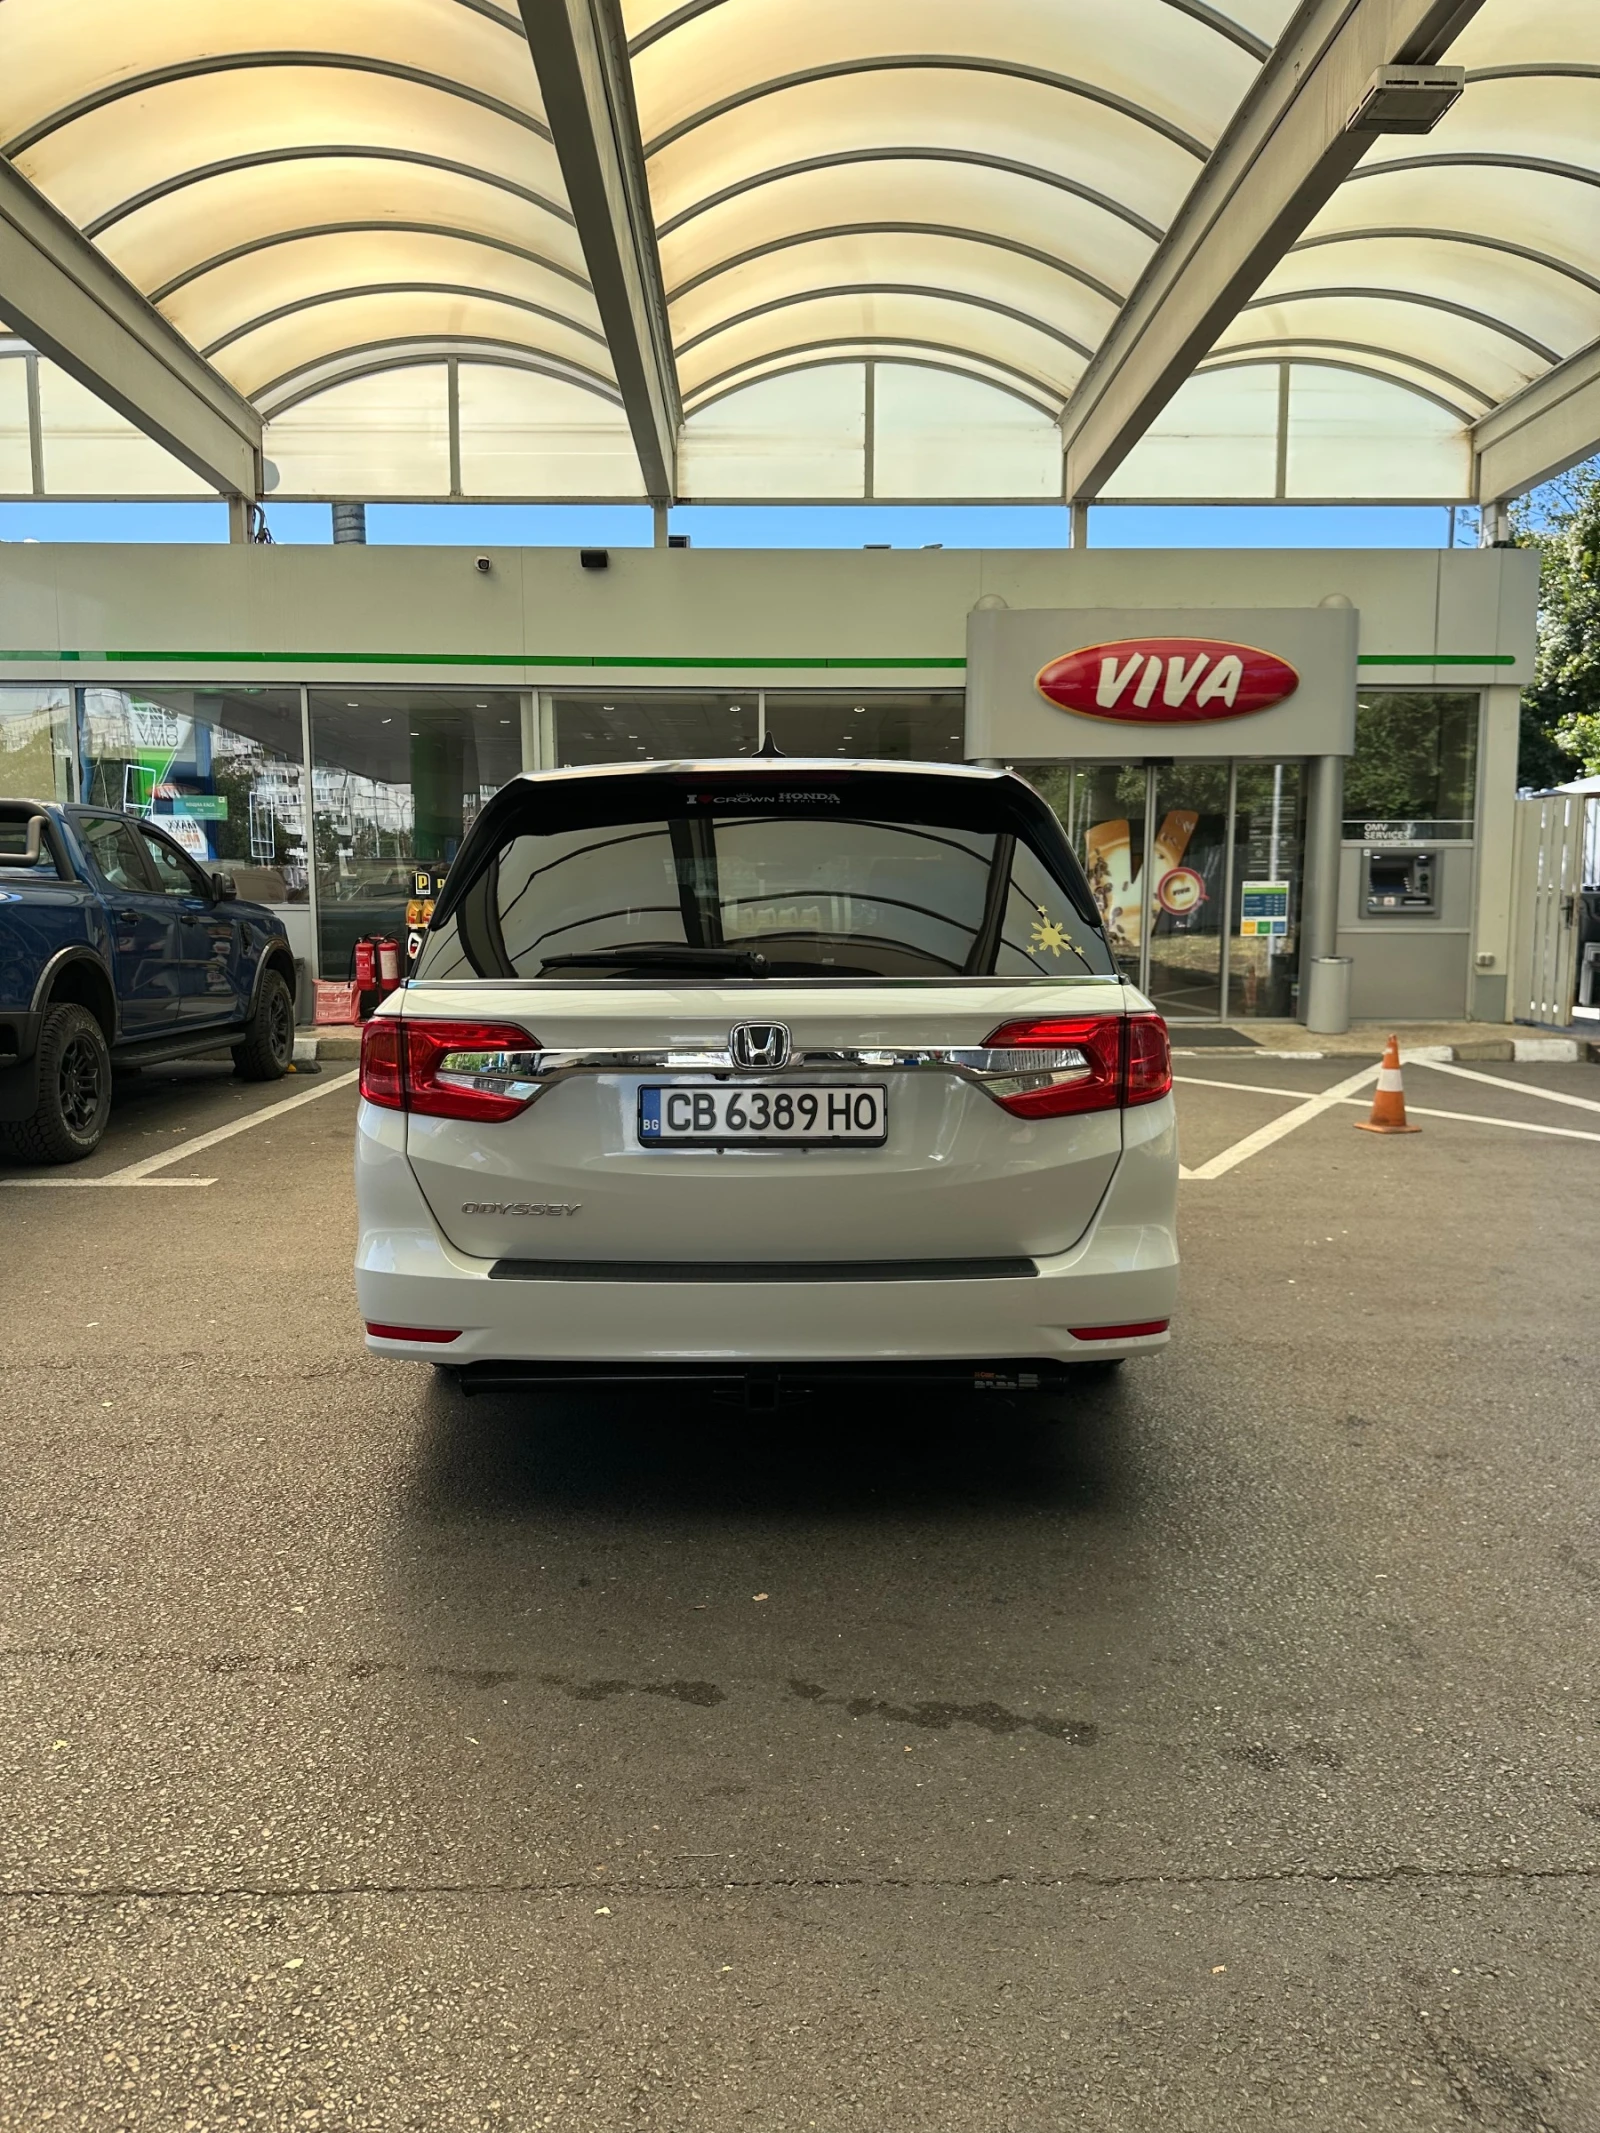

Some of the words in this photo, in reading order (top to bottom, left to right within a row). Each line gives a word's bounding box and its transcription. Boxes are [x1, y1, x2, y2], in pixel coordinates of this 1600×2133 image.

[1096, 652, 1243, 708] VIVA
[1364, 823, 1388, 831] OMV
[1364, 831, 1410, 840] SERVICES
[668, 1094, 717, 1131] CB
[725, 1093, 818, 1131] 6389
[828, 1093, 877, 1130] HO
[643, 1119, 659, 1130] BG
[462, 1202, 581, 1216] ODYSSEY
